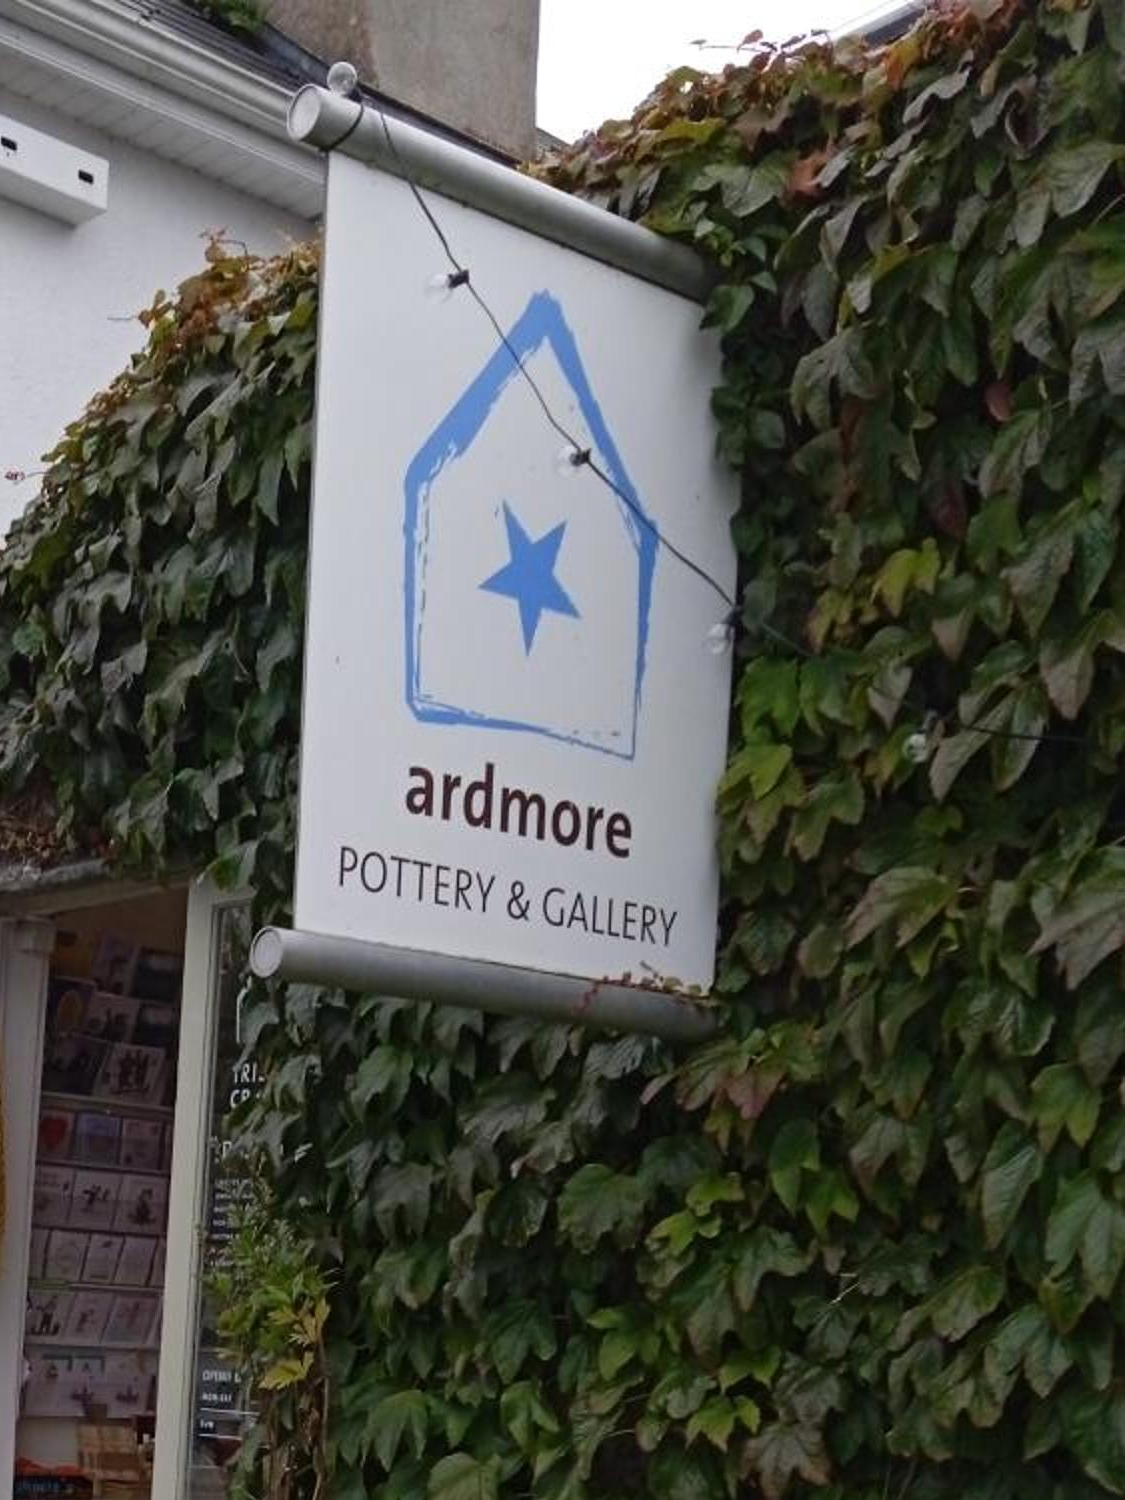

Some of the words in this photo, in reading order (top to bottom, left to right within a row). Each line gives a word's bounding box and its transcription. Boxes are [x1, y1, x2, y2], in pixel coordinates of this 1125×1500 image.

[405, 763, 632, 858] ardmore
[337, 845, 496, 913] POTTERY
[506, 880, 531, 921] &
[542, 886, 678, 947] GALLERY
